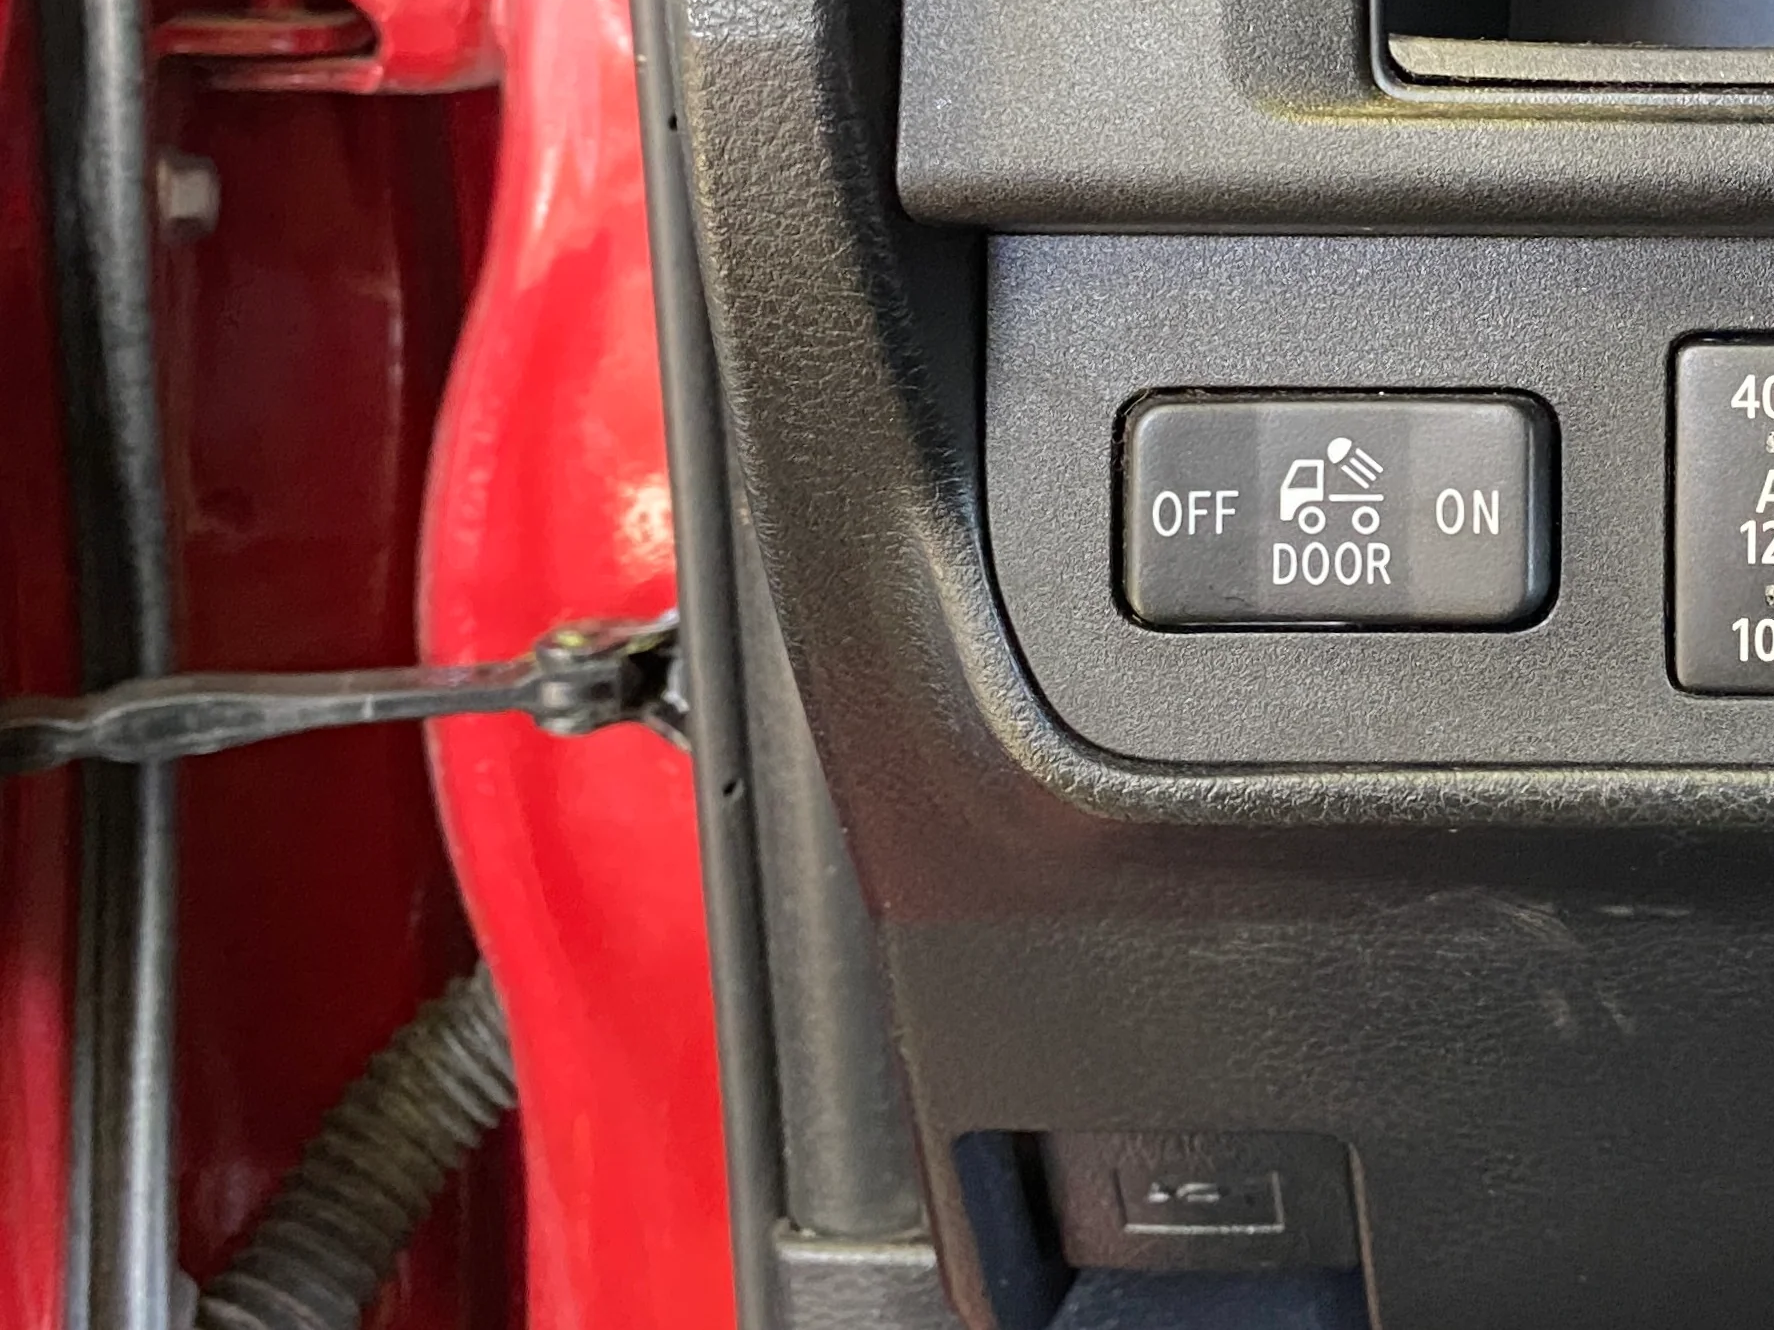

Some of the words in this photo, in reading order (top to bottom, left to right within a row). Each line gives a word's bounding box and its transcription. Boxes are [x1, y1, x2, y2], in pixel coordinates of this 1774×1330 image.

[1152, 490, 1239, 537] OFF
[1435, 488, 1500, 535] ON
[1272, 541, 1391, 586] DOOR
